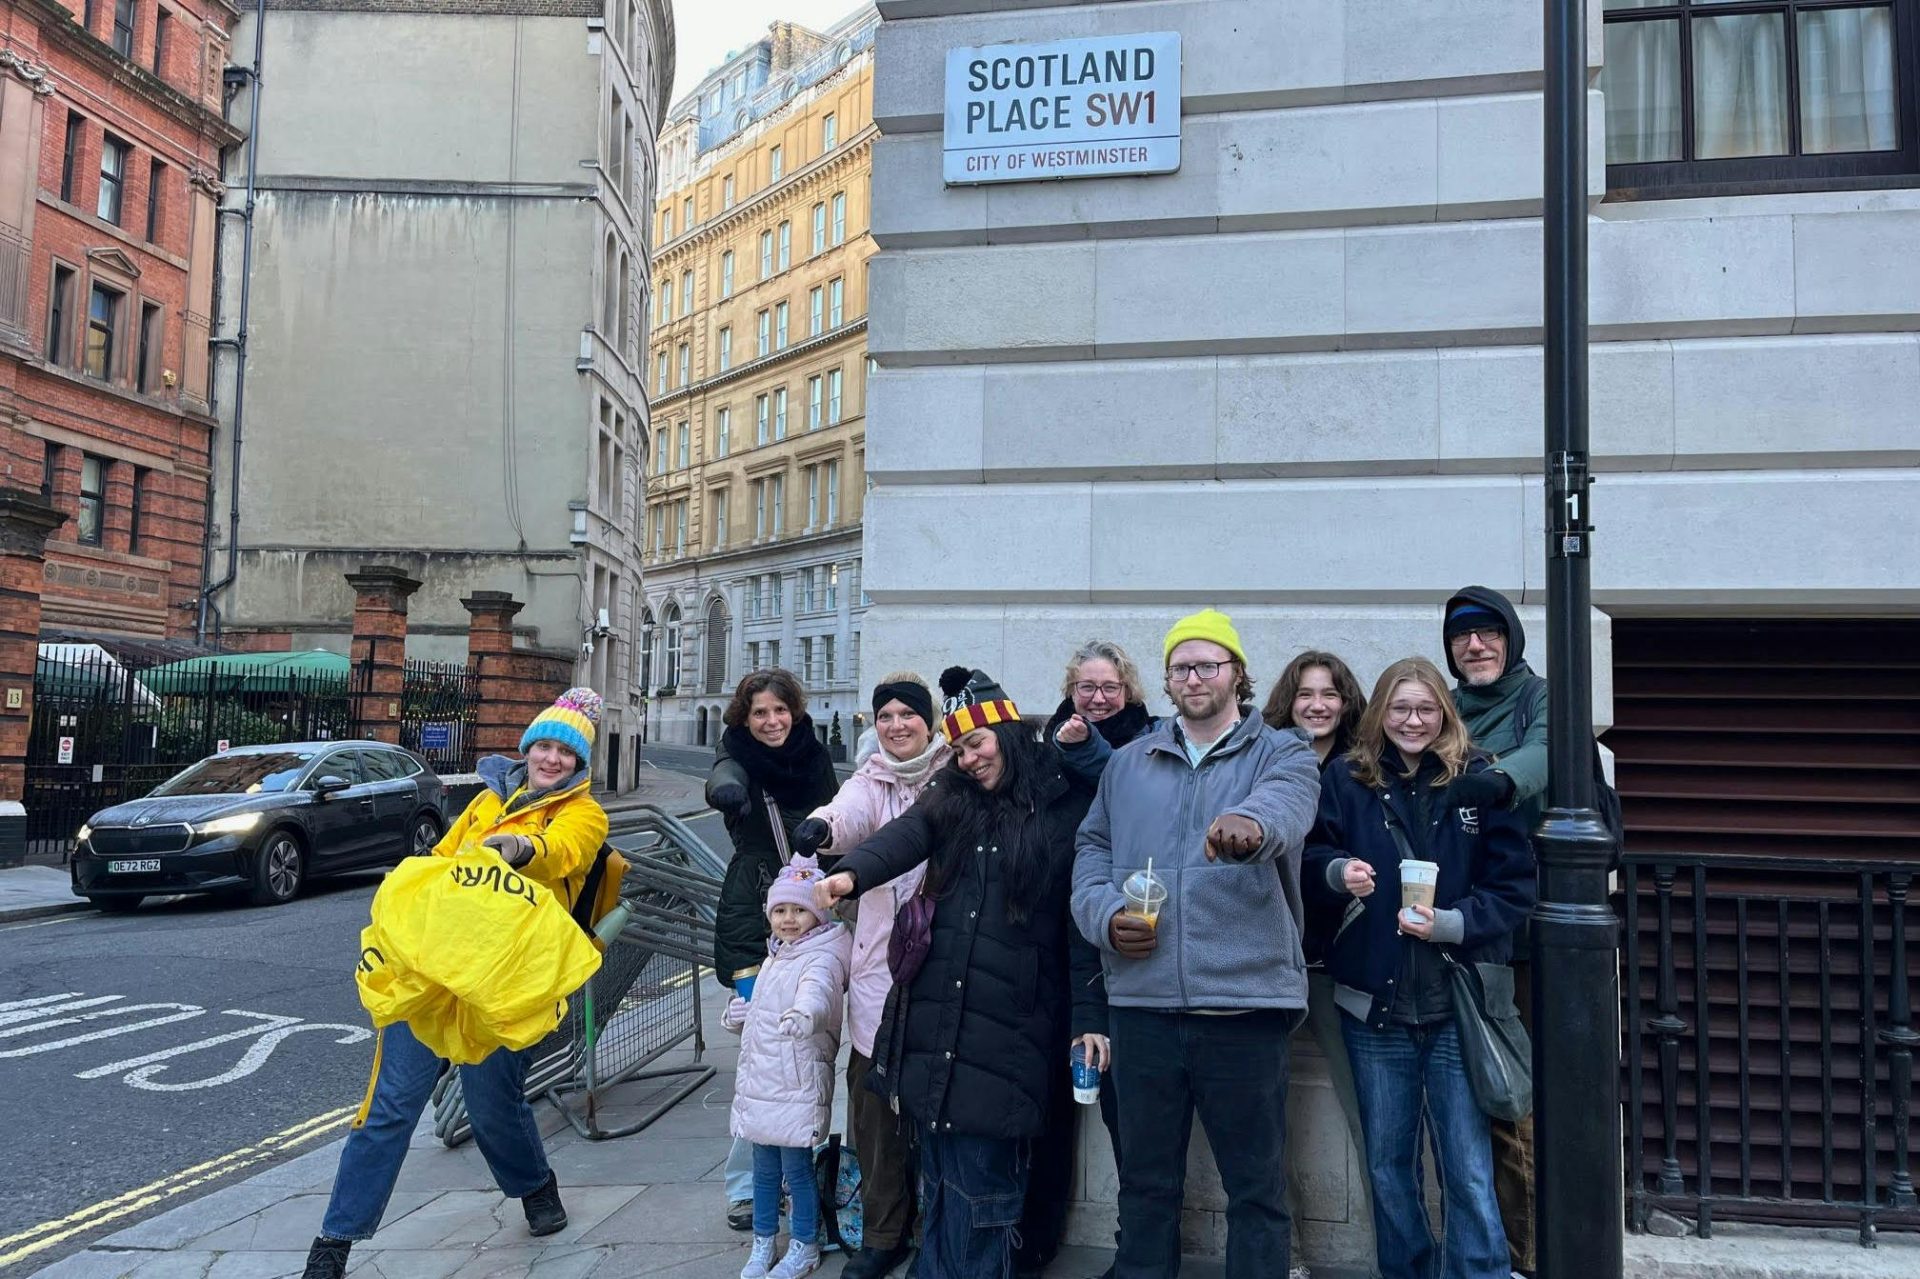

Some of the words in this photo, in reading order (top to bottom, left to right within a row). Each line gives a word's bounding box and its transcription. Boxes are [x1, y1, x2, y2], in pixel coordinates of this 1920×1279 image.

[968, 48, 1155, 92] SCOTLAND
[967, 96, 1071, 134] PLACE
[1086, 90, 1155, 127] SW1
[967, 154, 1000, 172] CITY
[1007, 153, 1026, 169] OF
[1032, 146, 1148, 168] WESTMINSTER
[10, 692, 20, 704] 13
[140, 860, 159, 871] RGZ
